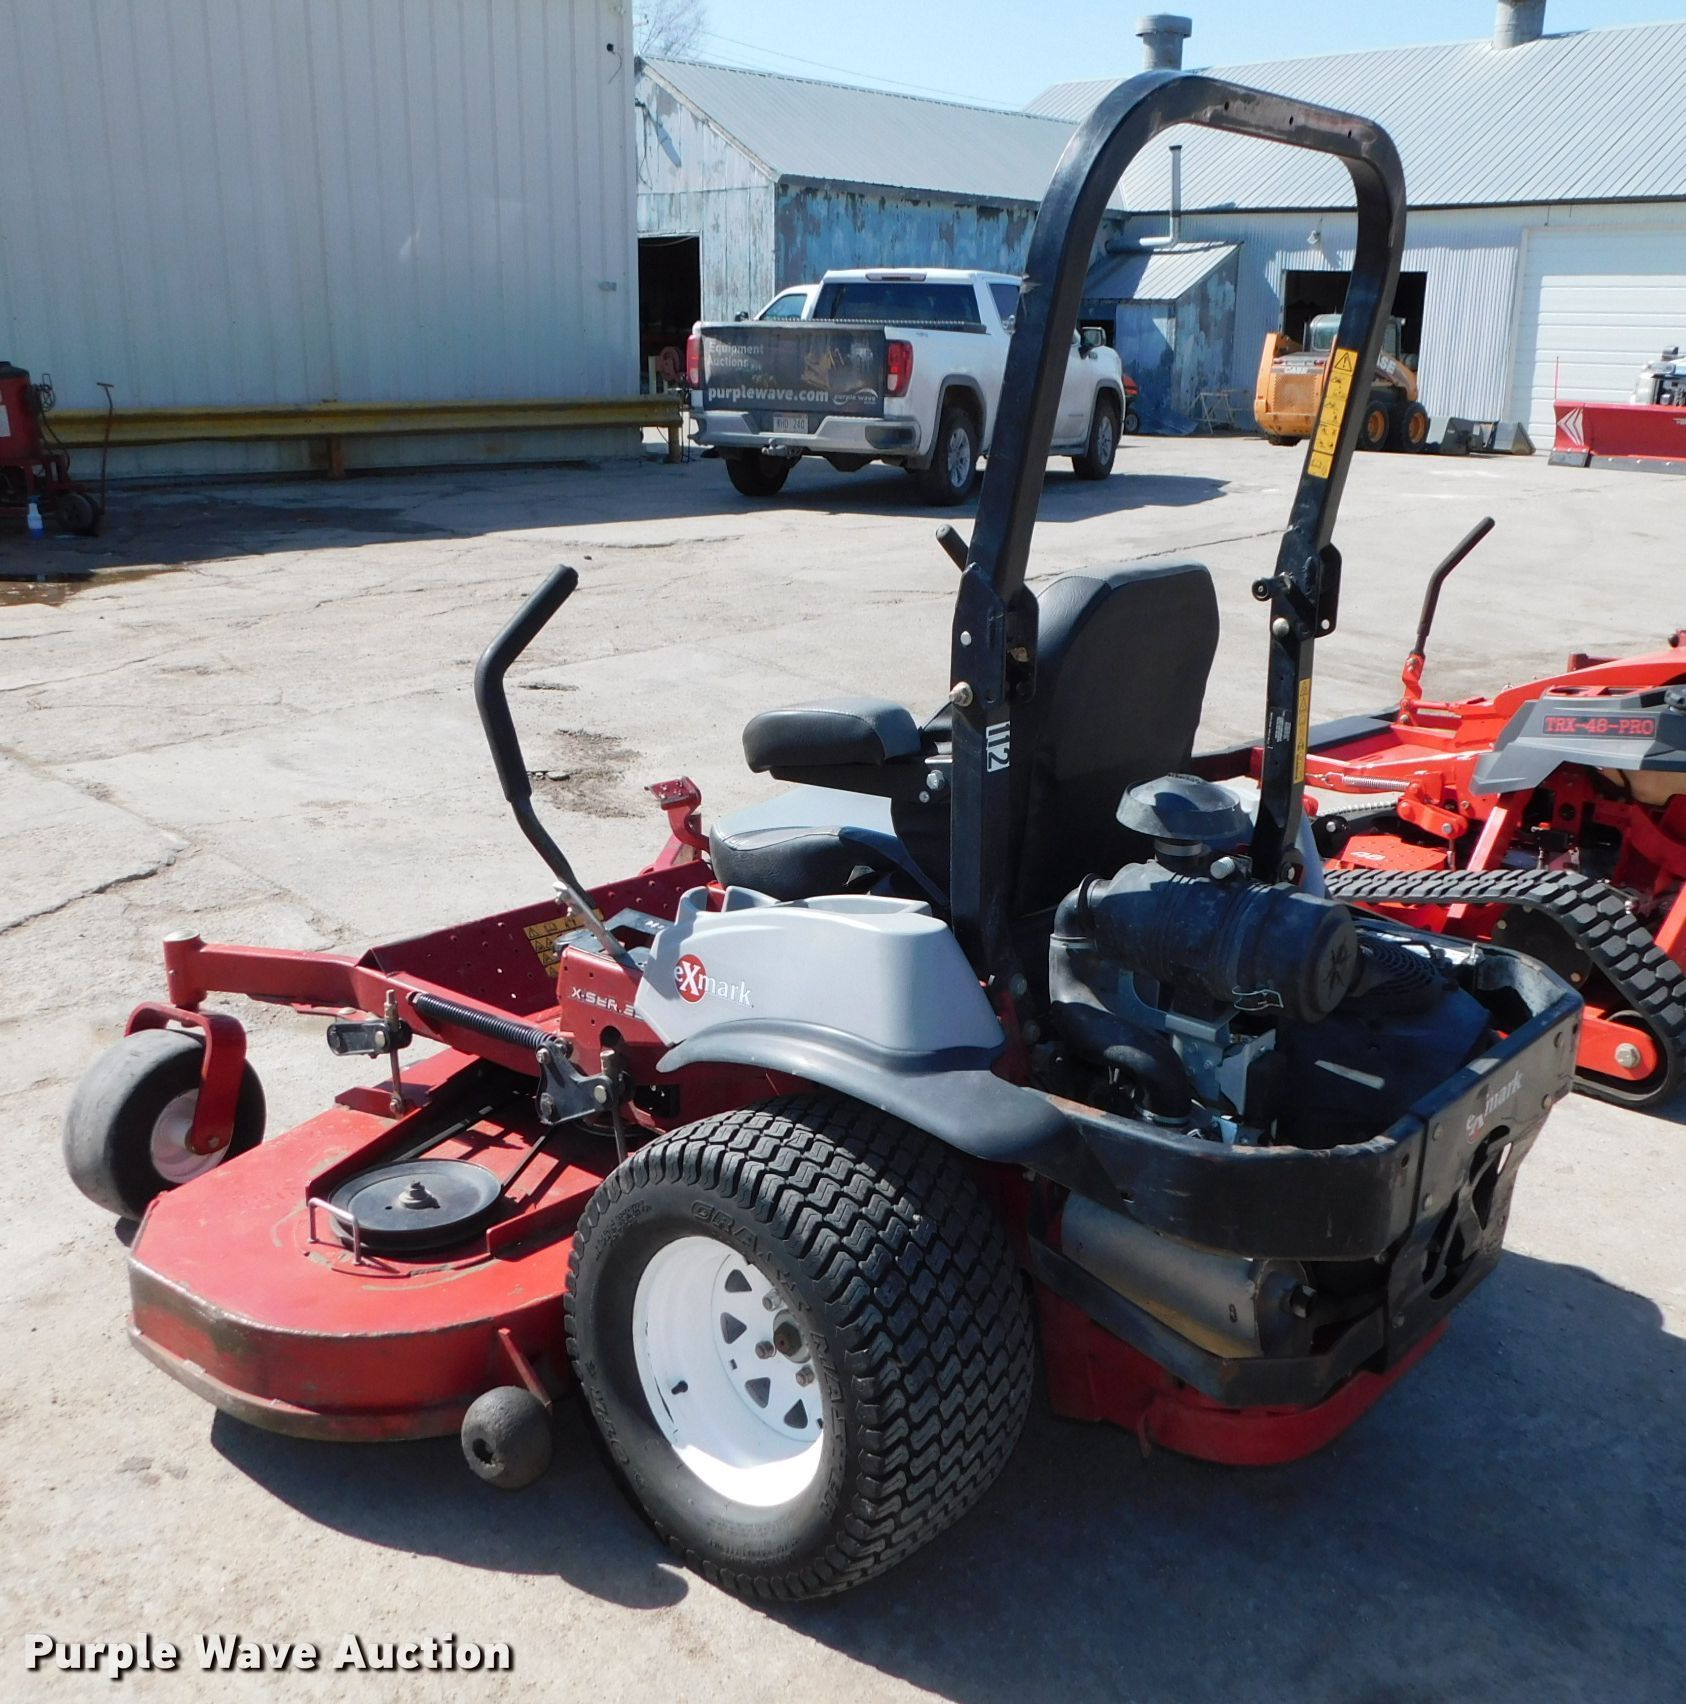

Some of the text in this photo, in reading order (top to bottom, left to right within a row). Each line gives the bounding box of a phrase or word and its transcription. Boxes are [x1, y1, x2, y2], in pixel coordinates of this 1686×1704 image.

[709, 342, 764, 356] Equipment
[707, 356, 748, 368] Auctions
[1376, 353, 1397, 375] SE
[708, 385, 828, 403] purplewave.com
[988, 723, 1011, 770] 112
